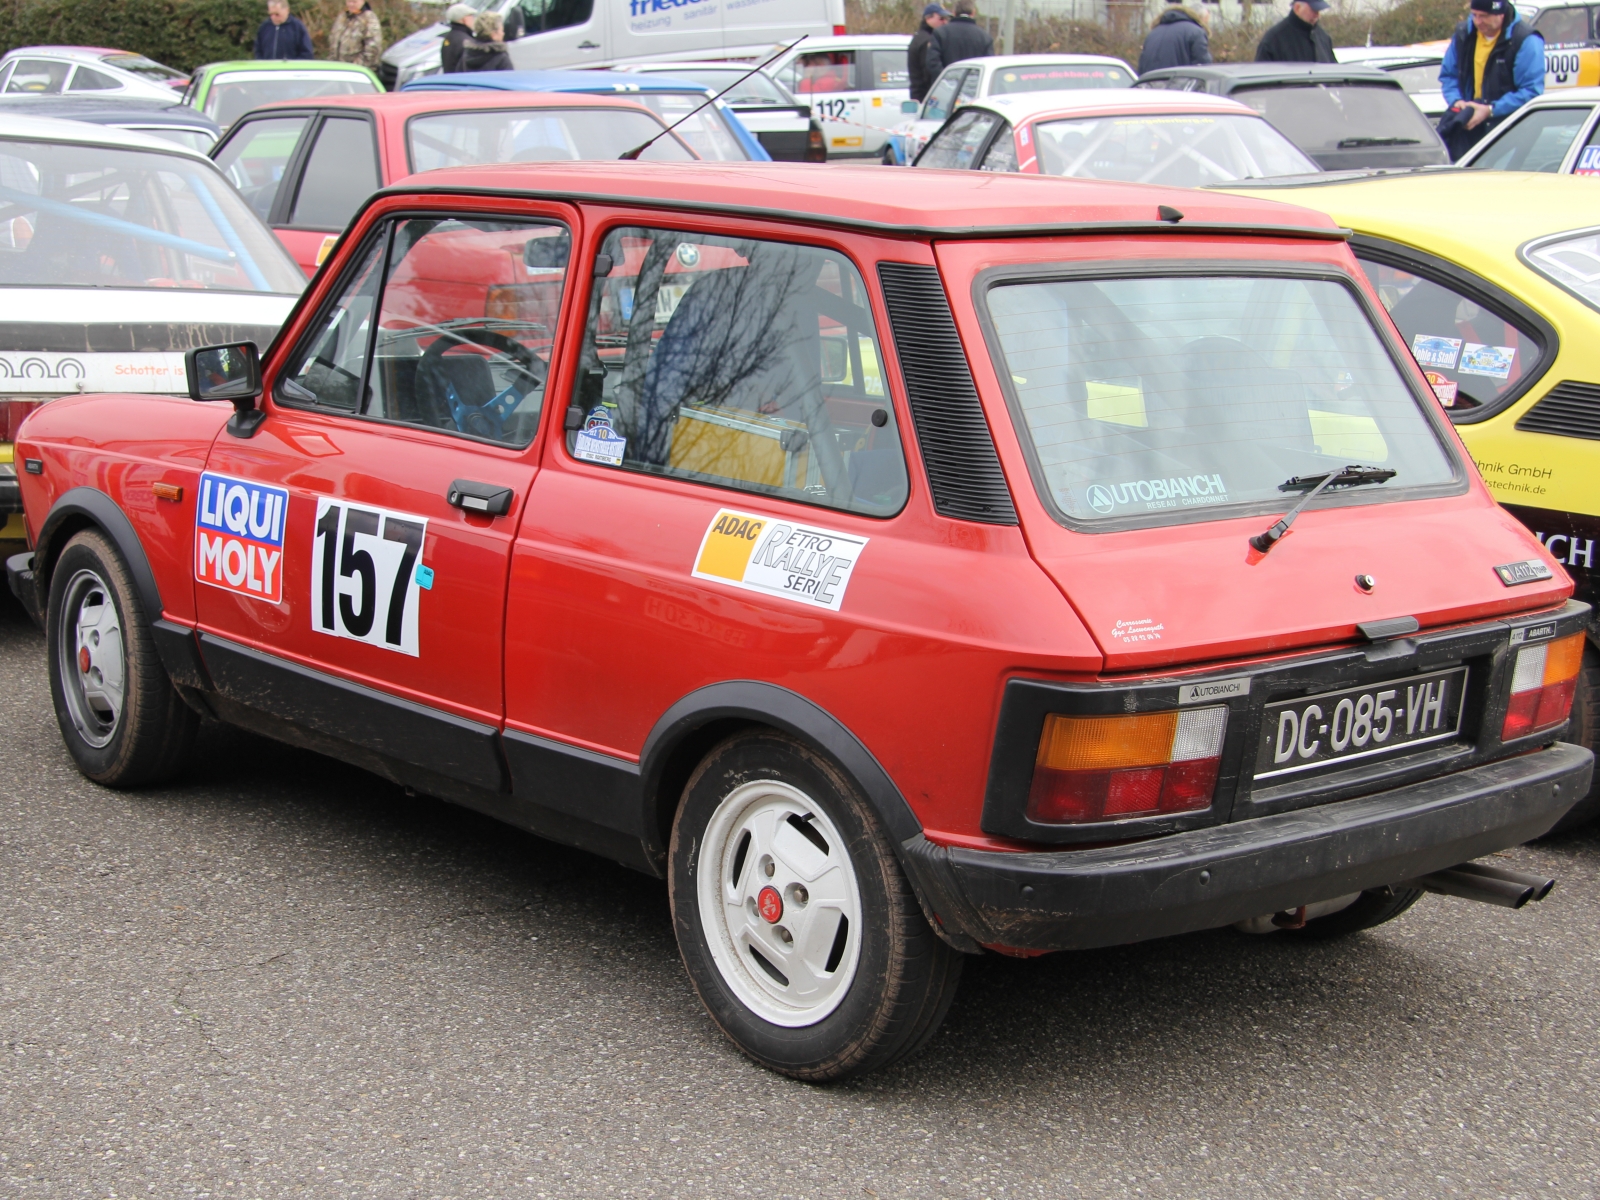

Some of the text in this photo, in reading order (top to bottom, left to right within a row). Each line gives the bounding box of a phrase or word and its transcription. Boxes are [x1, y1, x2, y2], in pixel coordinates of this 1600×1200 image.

[631, 16, 671, 31] heizung
[684, 5, 718, 20] sanitär
[816, 99, 847, 122] 112
[115, 364, 169, 376] Schotter
[1474, 459, 1553, 479] hnik GmbH
[200, 478, 283, 542] LIQUI
[1146, 494, 1229, 510] RESEAU CHARDONNET
[712, 515, 761, 541] ADAC
[199, 532, 281, 595] MOLY
[316, 505, 425, 647] 157
[1528, 626, 1552, 638] ABARTH
[1274, 680, 1446, 763] DC-085-VH
